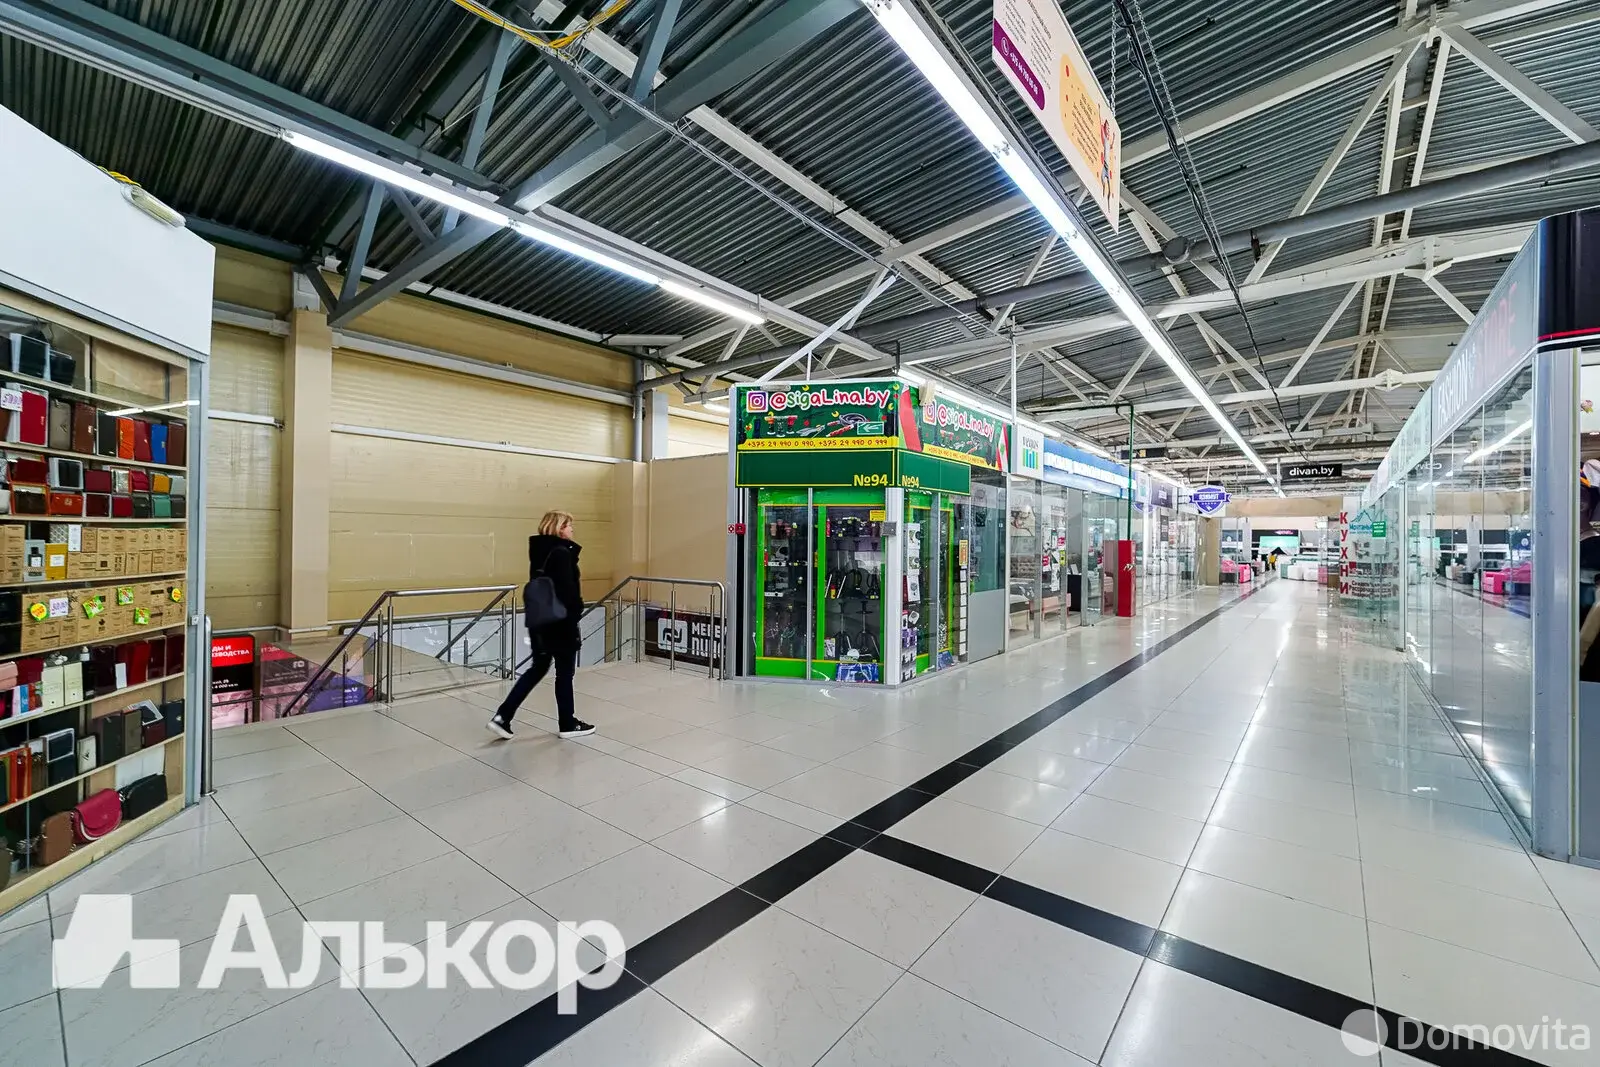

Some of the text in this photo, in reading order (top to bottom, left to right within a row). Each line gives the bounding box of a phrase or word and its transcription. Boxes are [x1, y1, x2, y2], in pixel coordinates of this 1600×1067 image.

[1437, 348, 1468, 430] FASHION
[770, 387, 890, 409] @sigaLina.by
[1289, 466, 1334, 476] divan.by
[853, 474, 888, 487] №94
[902, 475, 919, 488] №94
